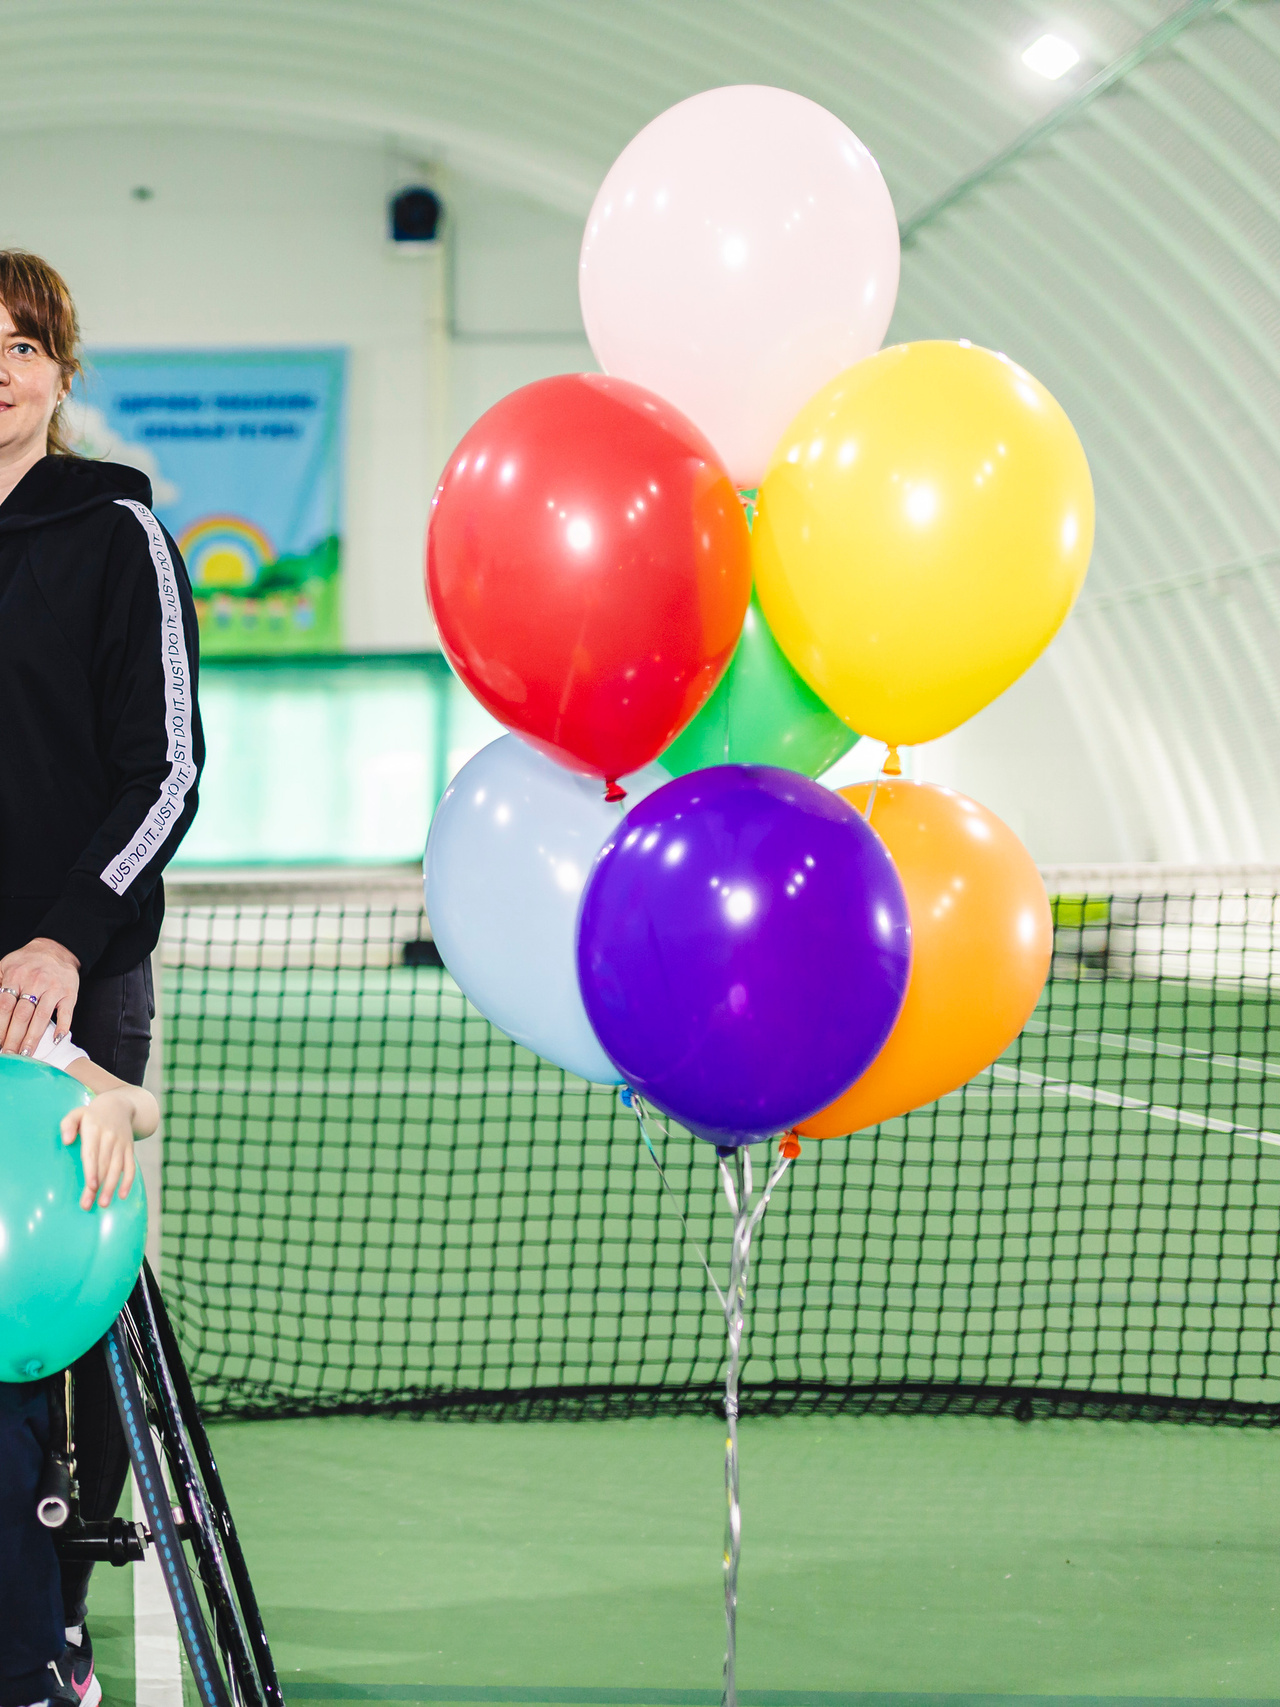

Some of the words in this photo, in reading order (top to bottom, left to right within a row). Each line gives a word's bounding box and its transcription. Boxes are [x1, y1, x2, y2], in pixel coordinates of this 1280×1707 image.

[156, 551, 171, 572] DO
[162, 574, 177, 612] JUST
[166, 614, 178, 629] IT.
[167, 632, 180, 656] DO
[170, 658, 185, 696] JUST
[172, 697, 186, 712] IT.
[172, 716, 186, 738] DO
[176, 768, 191, 785] IT.
[143, 828, 160, 846] IT.
